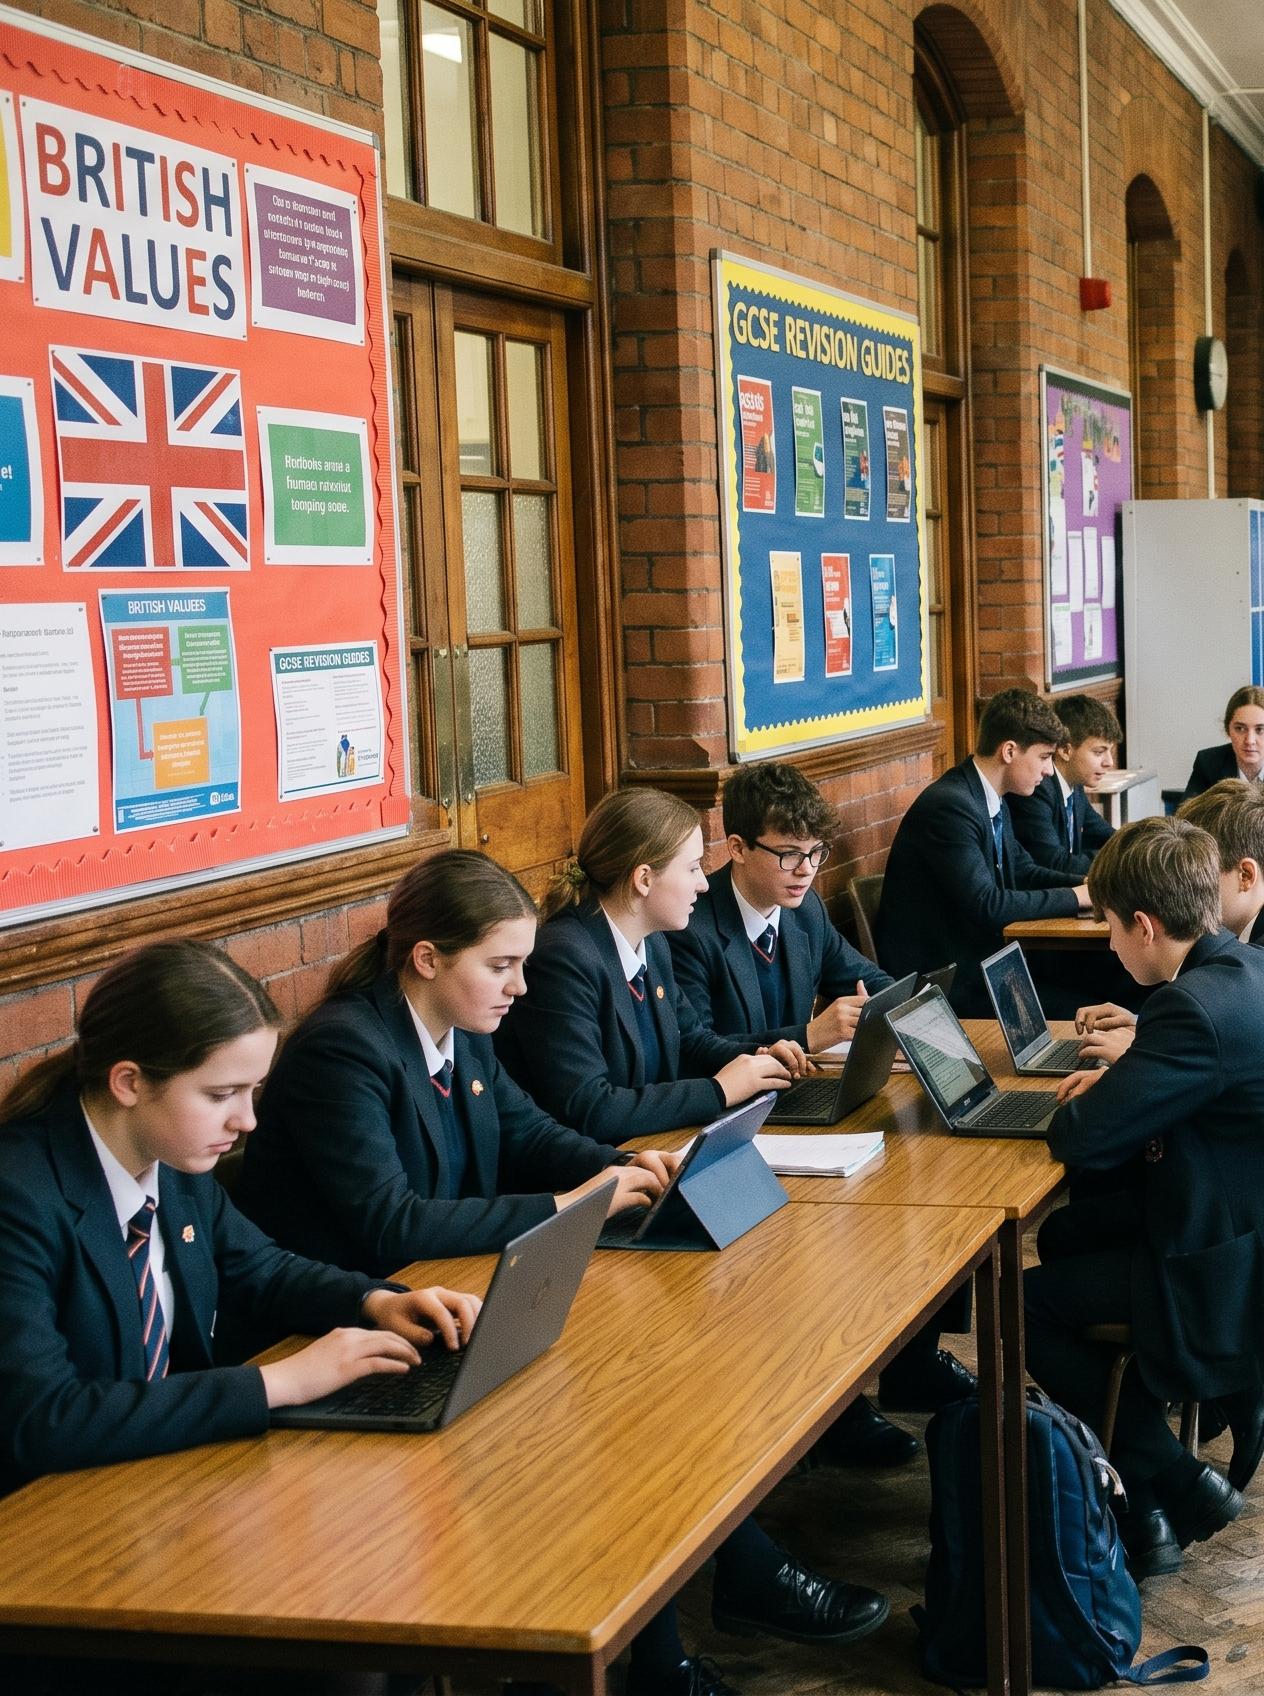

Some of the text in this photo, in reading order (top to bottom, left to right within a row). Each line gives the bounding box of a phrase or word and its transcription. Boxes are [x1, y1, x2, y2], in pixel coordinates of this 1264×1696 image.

[35, 122, 233, 238] BRITISH
[41, 216, 236, 321] VALUES
[733, 302, 911, 384] GCSE REVISION GUIDES
[279, 656, 302, 670] GCSE
